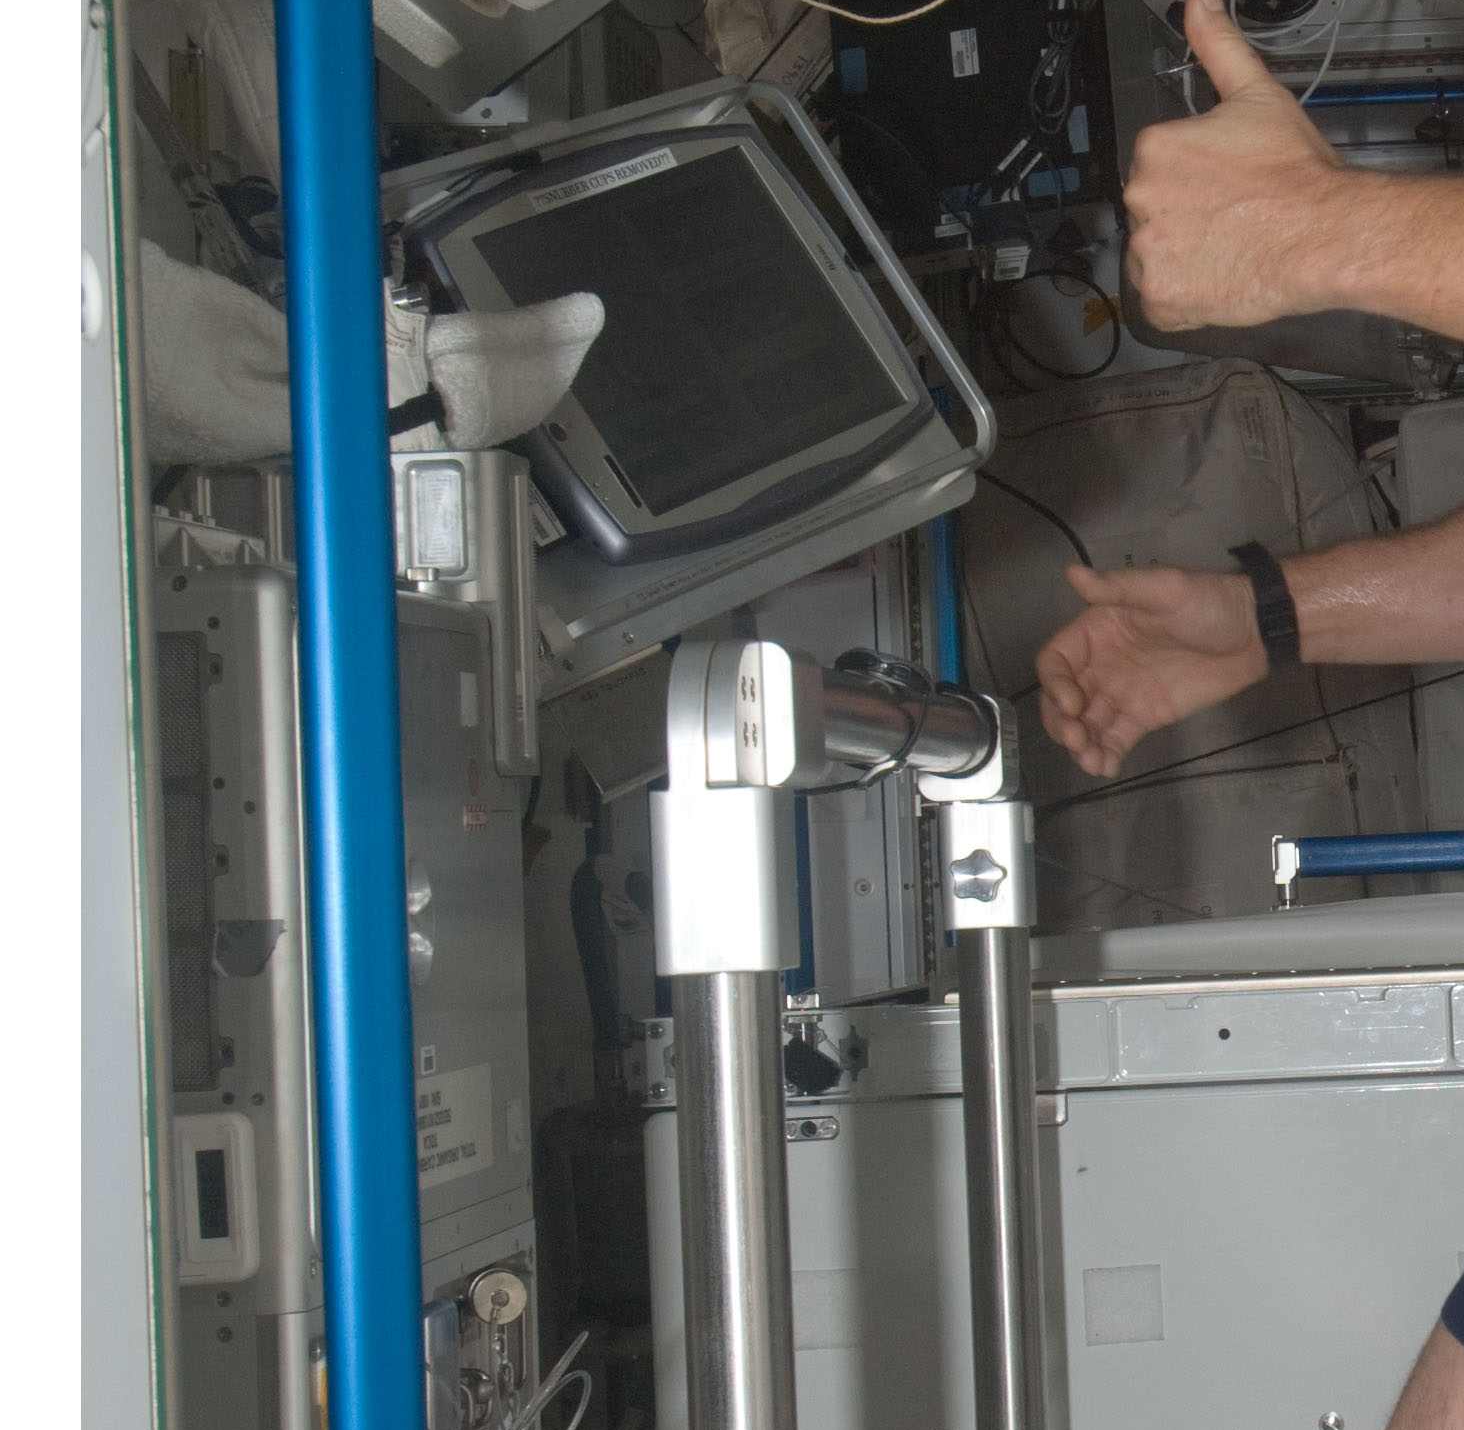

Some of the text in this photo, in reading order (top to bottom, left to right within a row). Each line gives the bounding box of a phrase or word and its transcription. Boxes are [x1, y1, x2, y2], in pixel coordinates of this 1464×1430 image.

[588, 169, 617, 190] CUPS
[436, 1146, 460, 1168] ORGANIC
[459, 1141, 477, 1160] TOTAL
